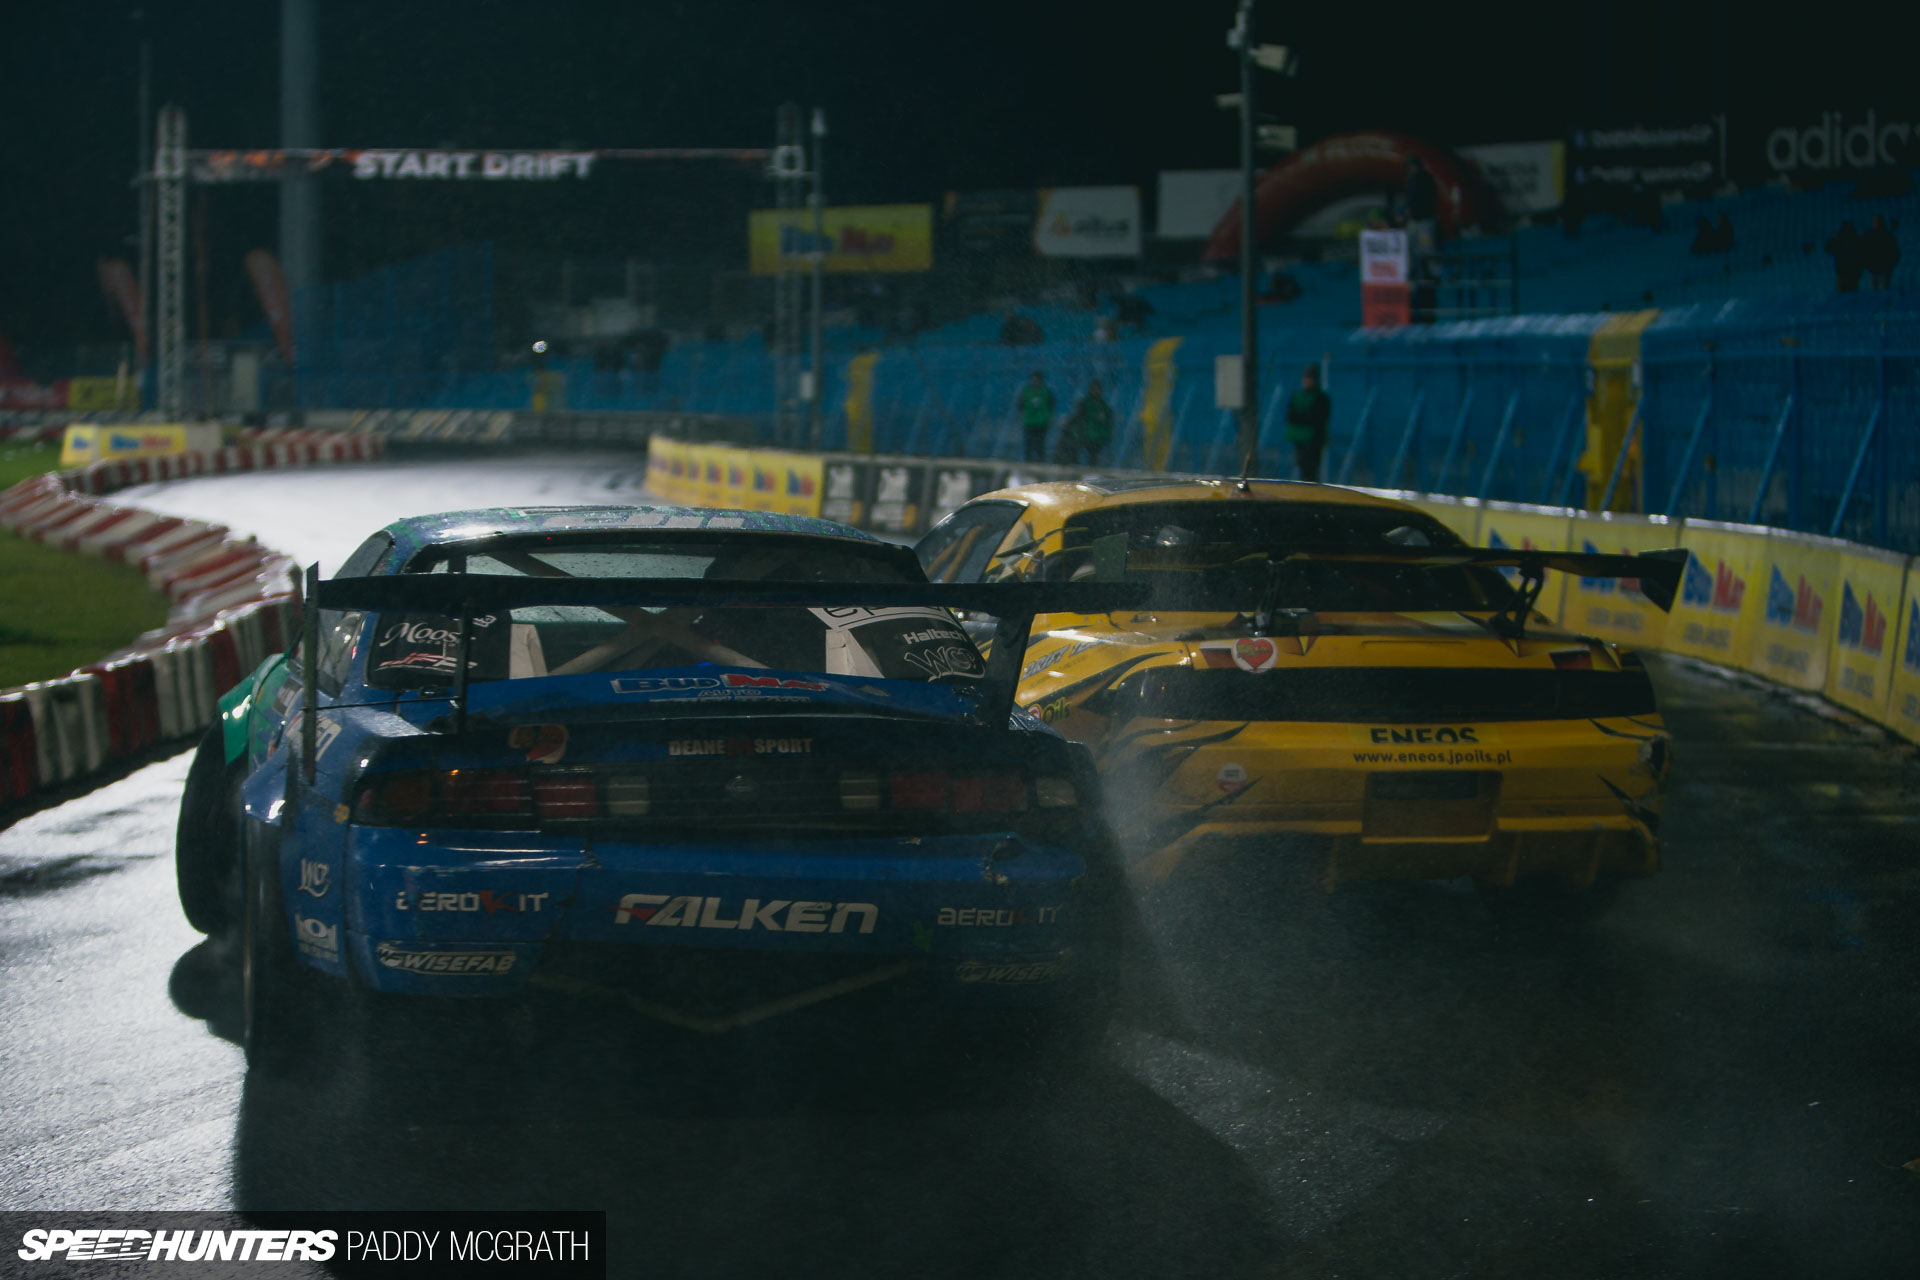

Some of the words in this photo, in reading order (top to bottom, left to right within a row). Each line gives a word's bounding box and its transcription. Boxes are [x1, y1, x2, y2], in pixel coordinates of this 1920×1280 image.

[353, 151, 477, 181] START
[482, 151, 598, 181] DRIFT
[903, 629, 967, 645] Haltech
[1370, 727, 1479, 744] ENEOS
[668, 740, 727, 756] DEANE
[754, 737, 815, 754] SPORT
[1353, 749, 1513, 765] www.eneos.jpoils.pl
[608, 893, 880, 934] FALKEN
[404, 951, 517, 972] WISEFAB
